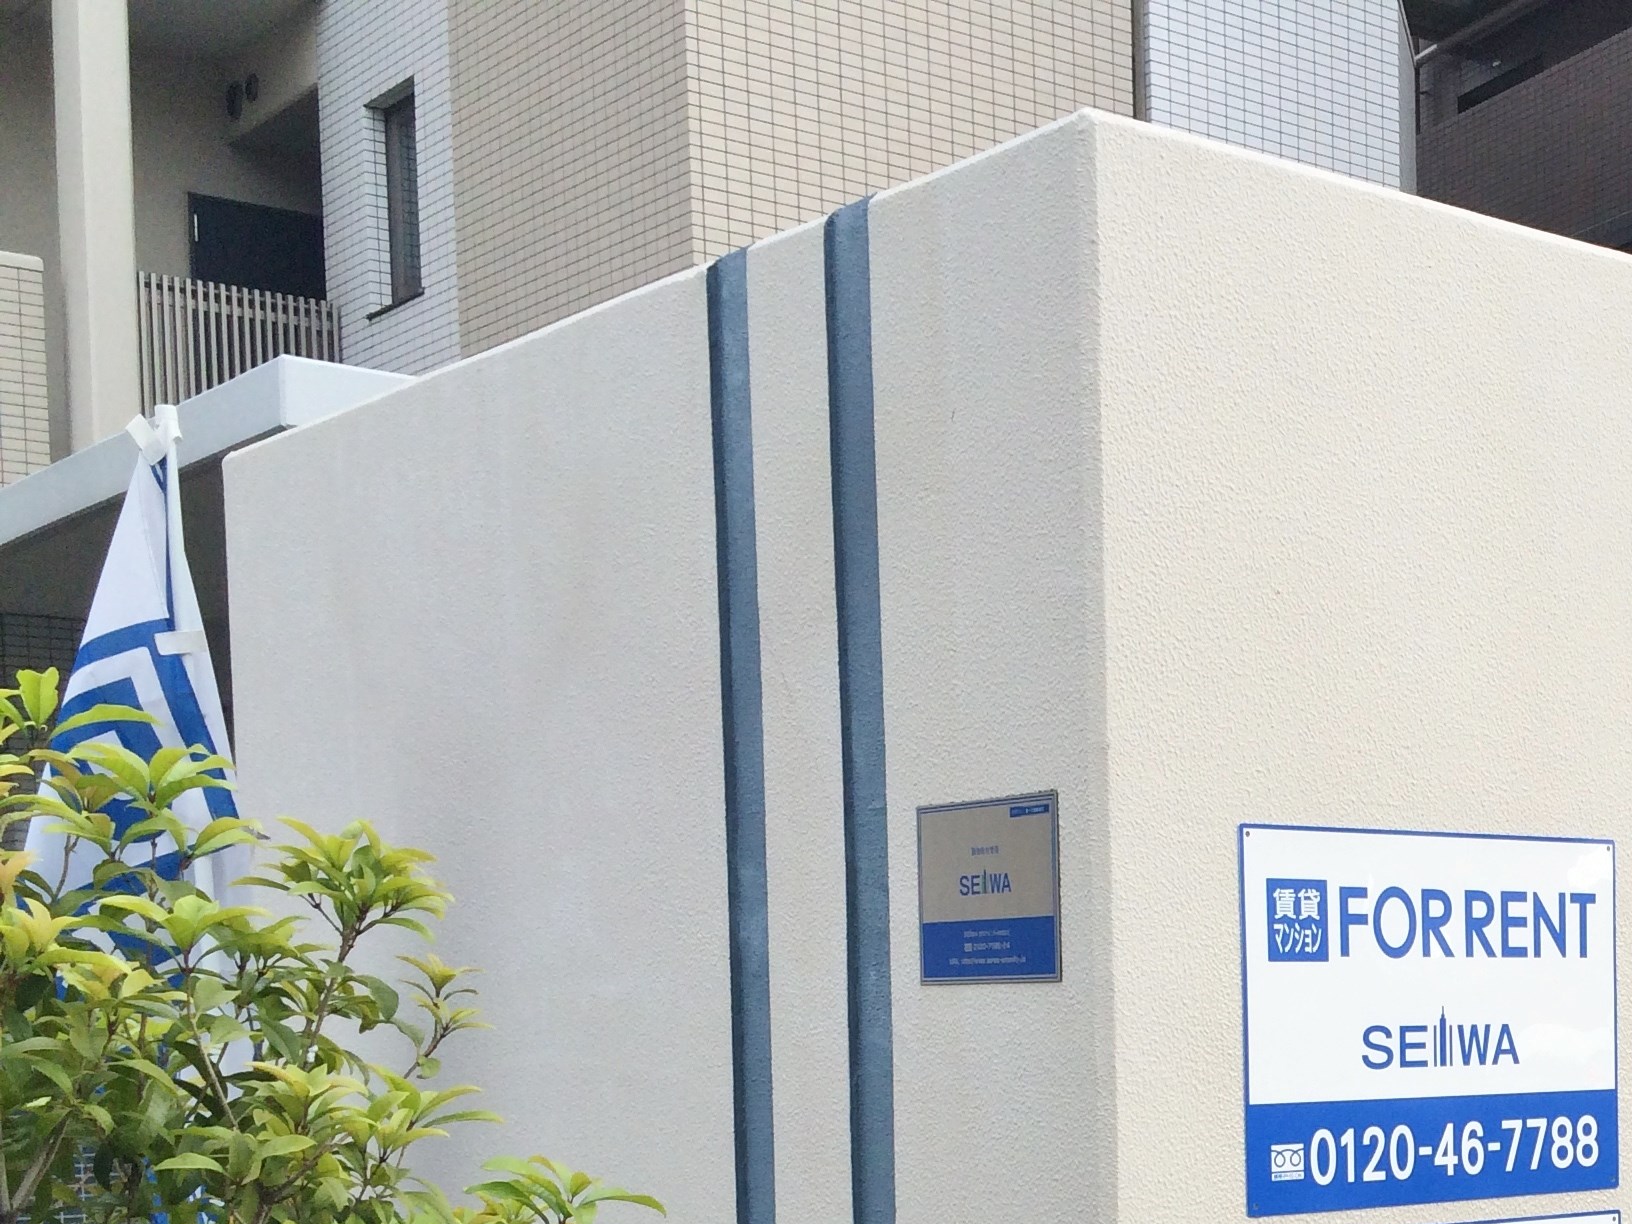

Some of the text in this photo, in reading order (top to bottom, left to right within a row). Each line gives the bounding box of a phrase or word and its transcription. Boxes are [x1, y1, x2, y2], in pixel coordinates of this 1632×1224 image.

[1272, 887, 1321, 921] 賃貸
[1339, 886, 1597, 959] FOR RENT
[1272, 922, 1322, 954] マンション
[1310, 1114, 1600, 1186] 0120-46-7788
